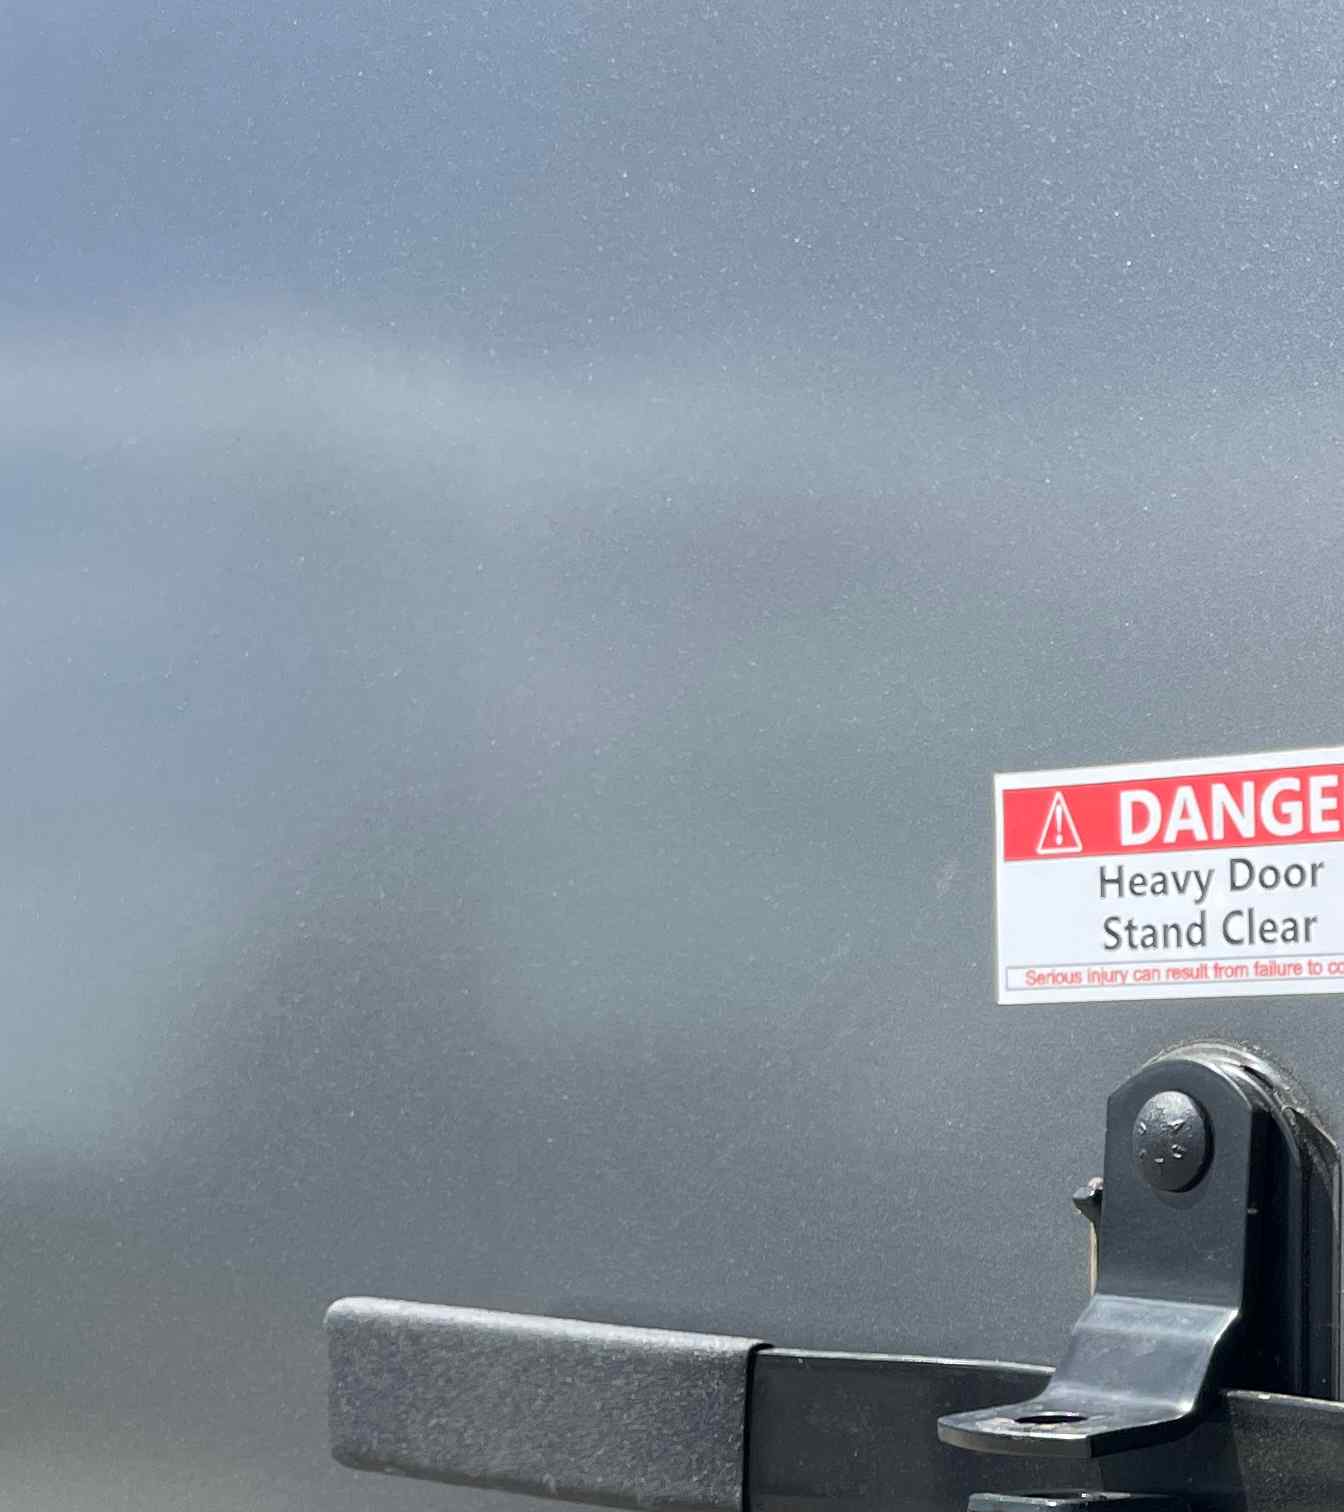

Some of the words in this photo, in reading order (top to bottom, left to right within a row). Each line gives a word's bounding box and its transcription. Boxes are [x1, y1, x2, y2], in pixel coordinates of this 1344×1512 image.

[1099, 864, 1214, 905] Heavy
[1229, 857, 1324, 892] Door
[1103, 909, 1206, 951] Stand
[1222, 907, 1318, 945] Clear
[1025, 969, 1082, 986] Serious
[1087, 967, 1128, 985] injury
[1133, 968, 1160, 982] can
[1166, 963, 1209, 980] result
[1213, 961, 1248, 979] from
[1253, 960, 1302, 976] failure
[1307, 959, 1323, 975] to
